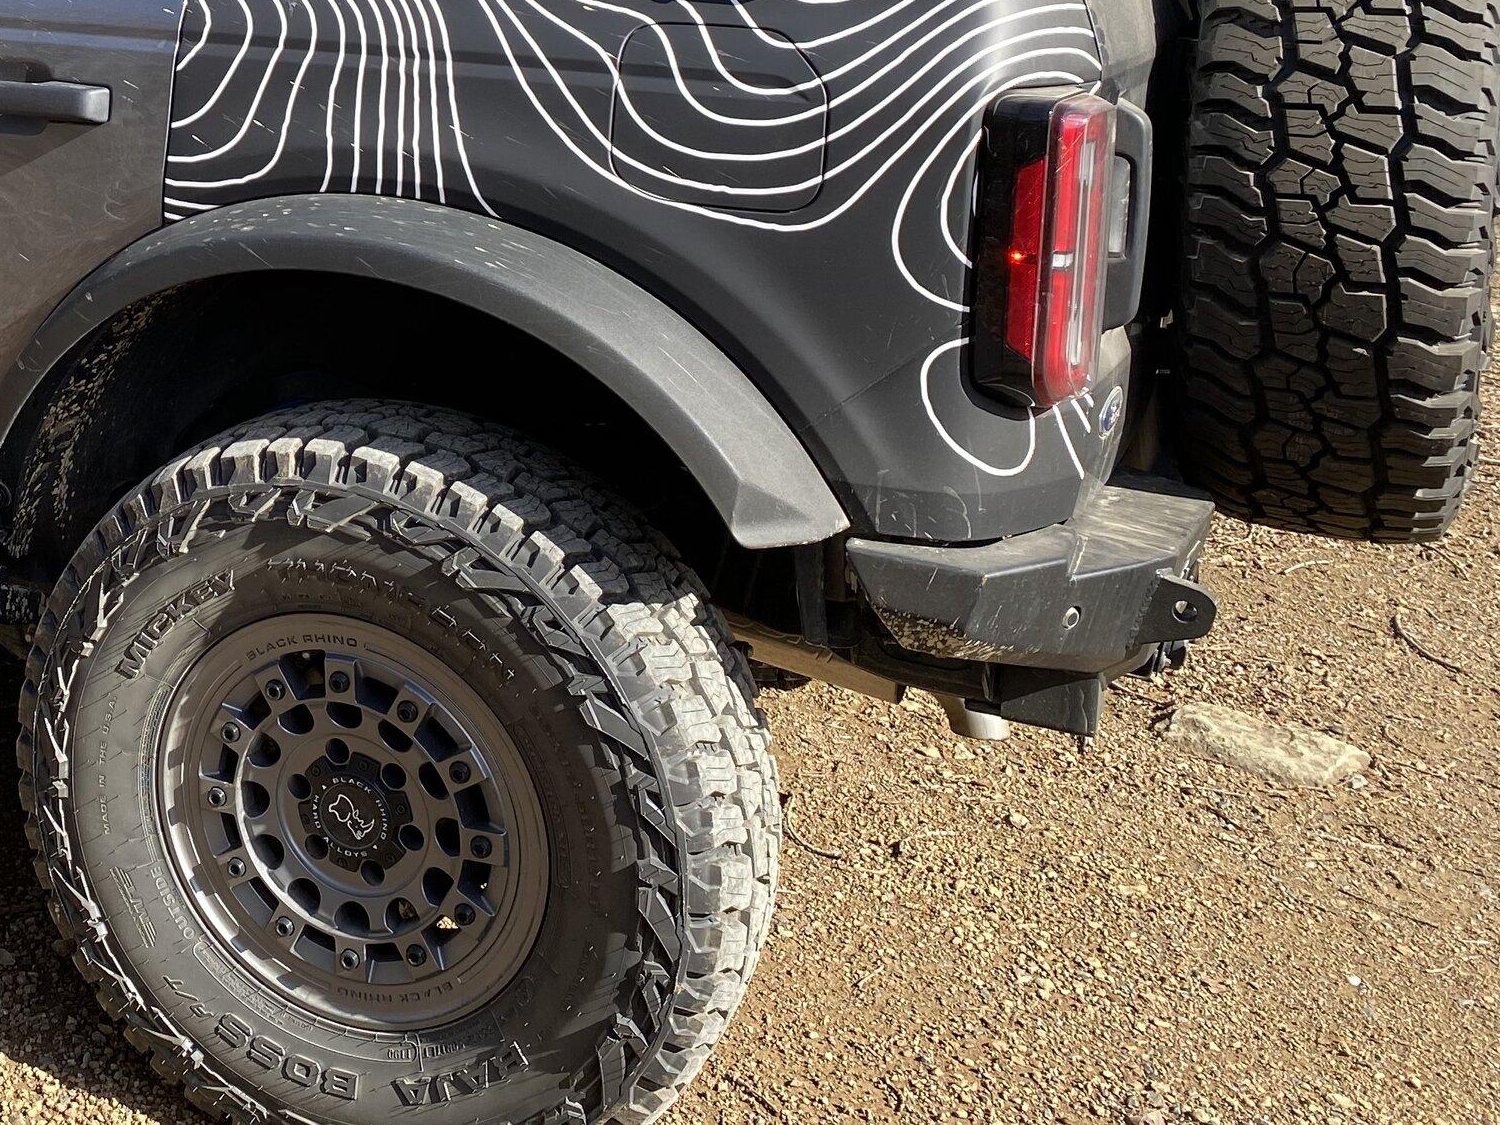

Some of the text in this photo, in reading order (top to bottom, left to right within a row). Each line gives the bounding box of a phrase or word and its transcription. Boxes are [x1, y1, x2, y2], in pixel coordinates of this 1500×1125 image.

[114, 569, 236, 679] MICKEY
[246, 633, 358, 662] BLACK RHINO
[98, 774, 106, 788] IN
[99, 741, 108, 765] THE
[99, 795, 112, 836] MADE
[312, 795, 368, 858] HARD ALLOYS
[332, 777, 388, 841] BLACK RHINO
[150, 865, 196, 940] OUTSIDE
[213, 1011, 360, 1102] BOSS
[391, 1040, 529, 1107] BAJA
